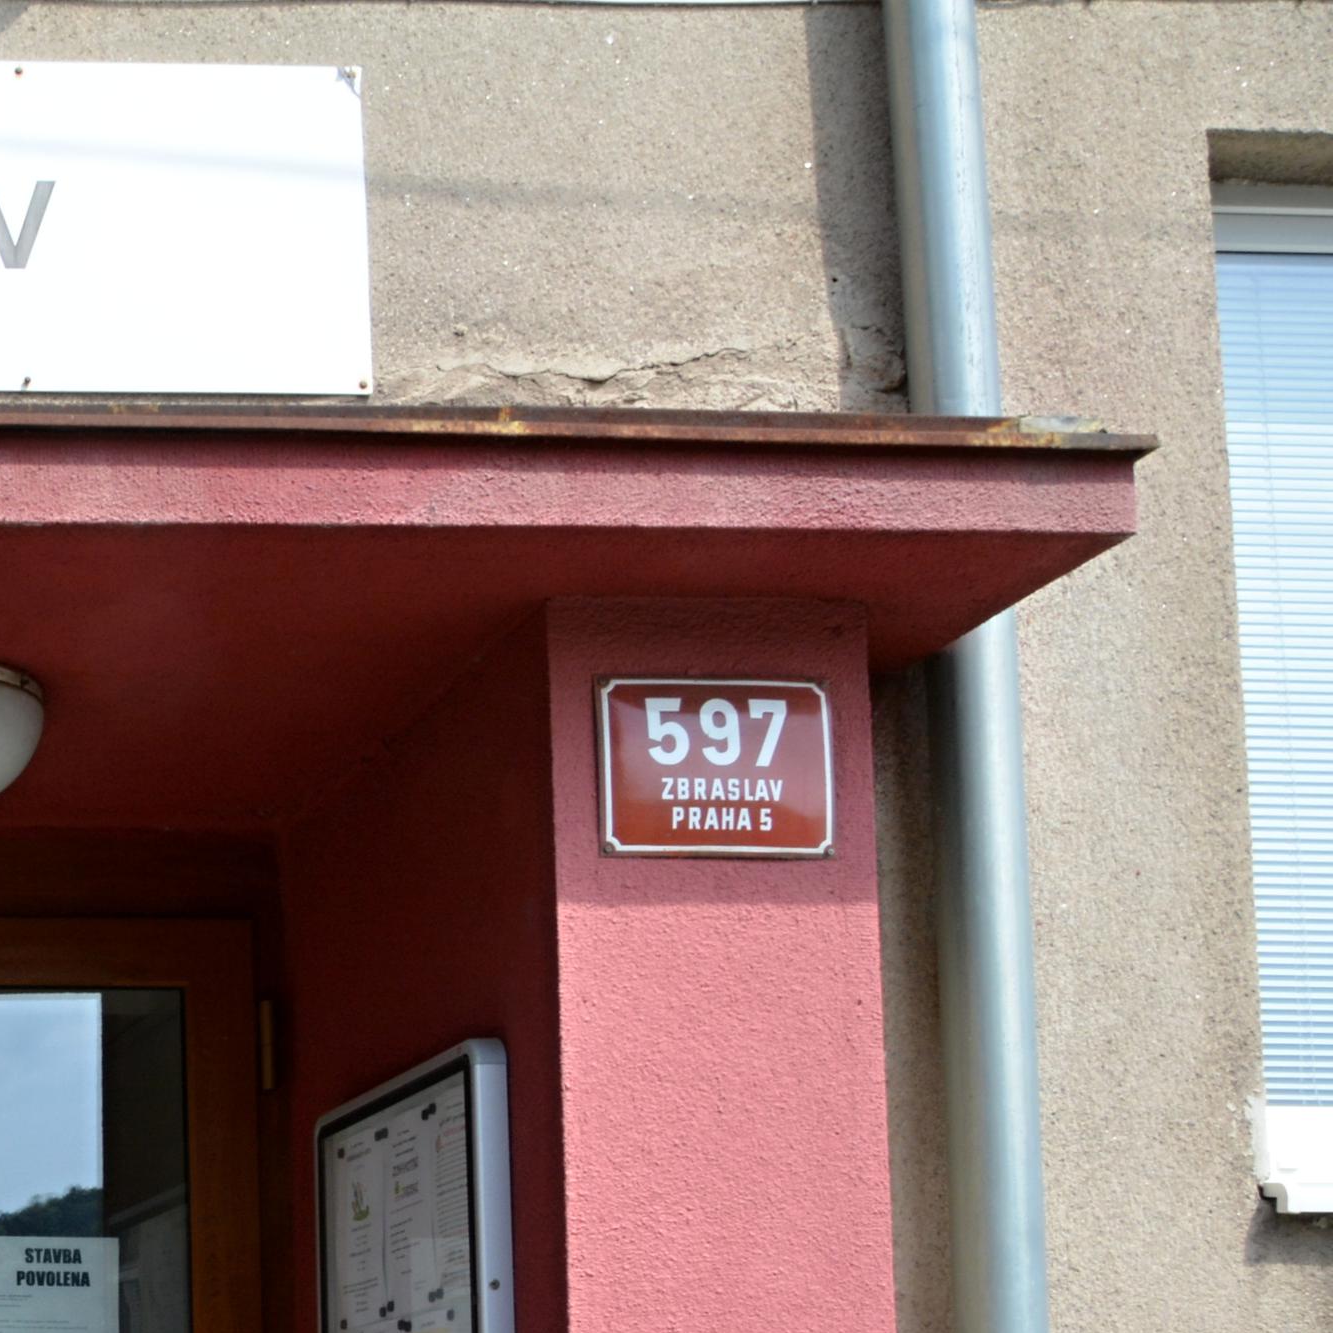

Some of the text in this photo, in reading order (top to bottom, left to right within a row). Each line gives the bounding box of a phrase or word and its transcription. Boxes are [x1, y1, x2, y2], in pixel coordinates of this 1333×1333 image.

[645, 697, 787, 767] 597
[661, 777, 783, 802] ZBRASLAV
[672, 806, 773, 831] PRAHA 5
[25, 1248, 82, 1264] STAVBA
[16, 1270, 90, 1286] POVOLENA
